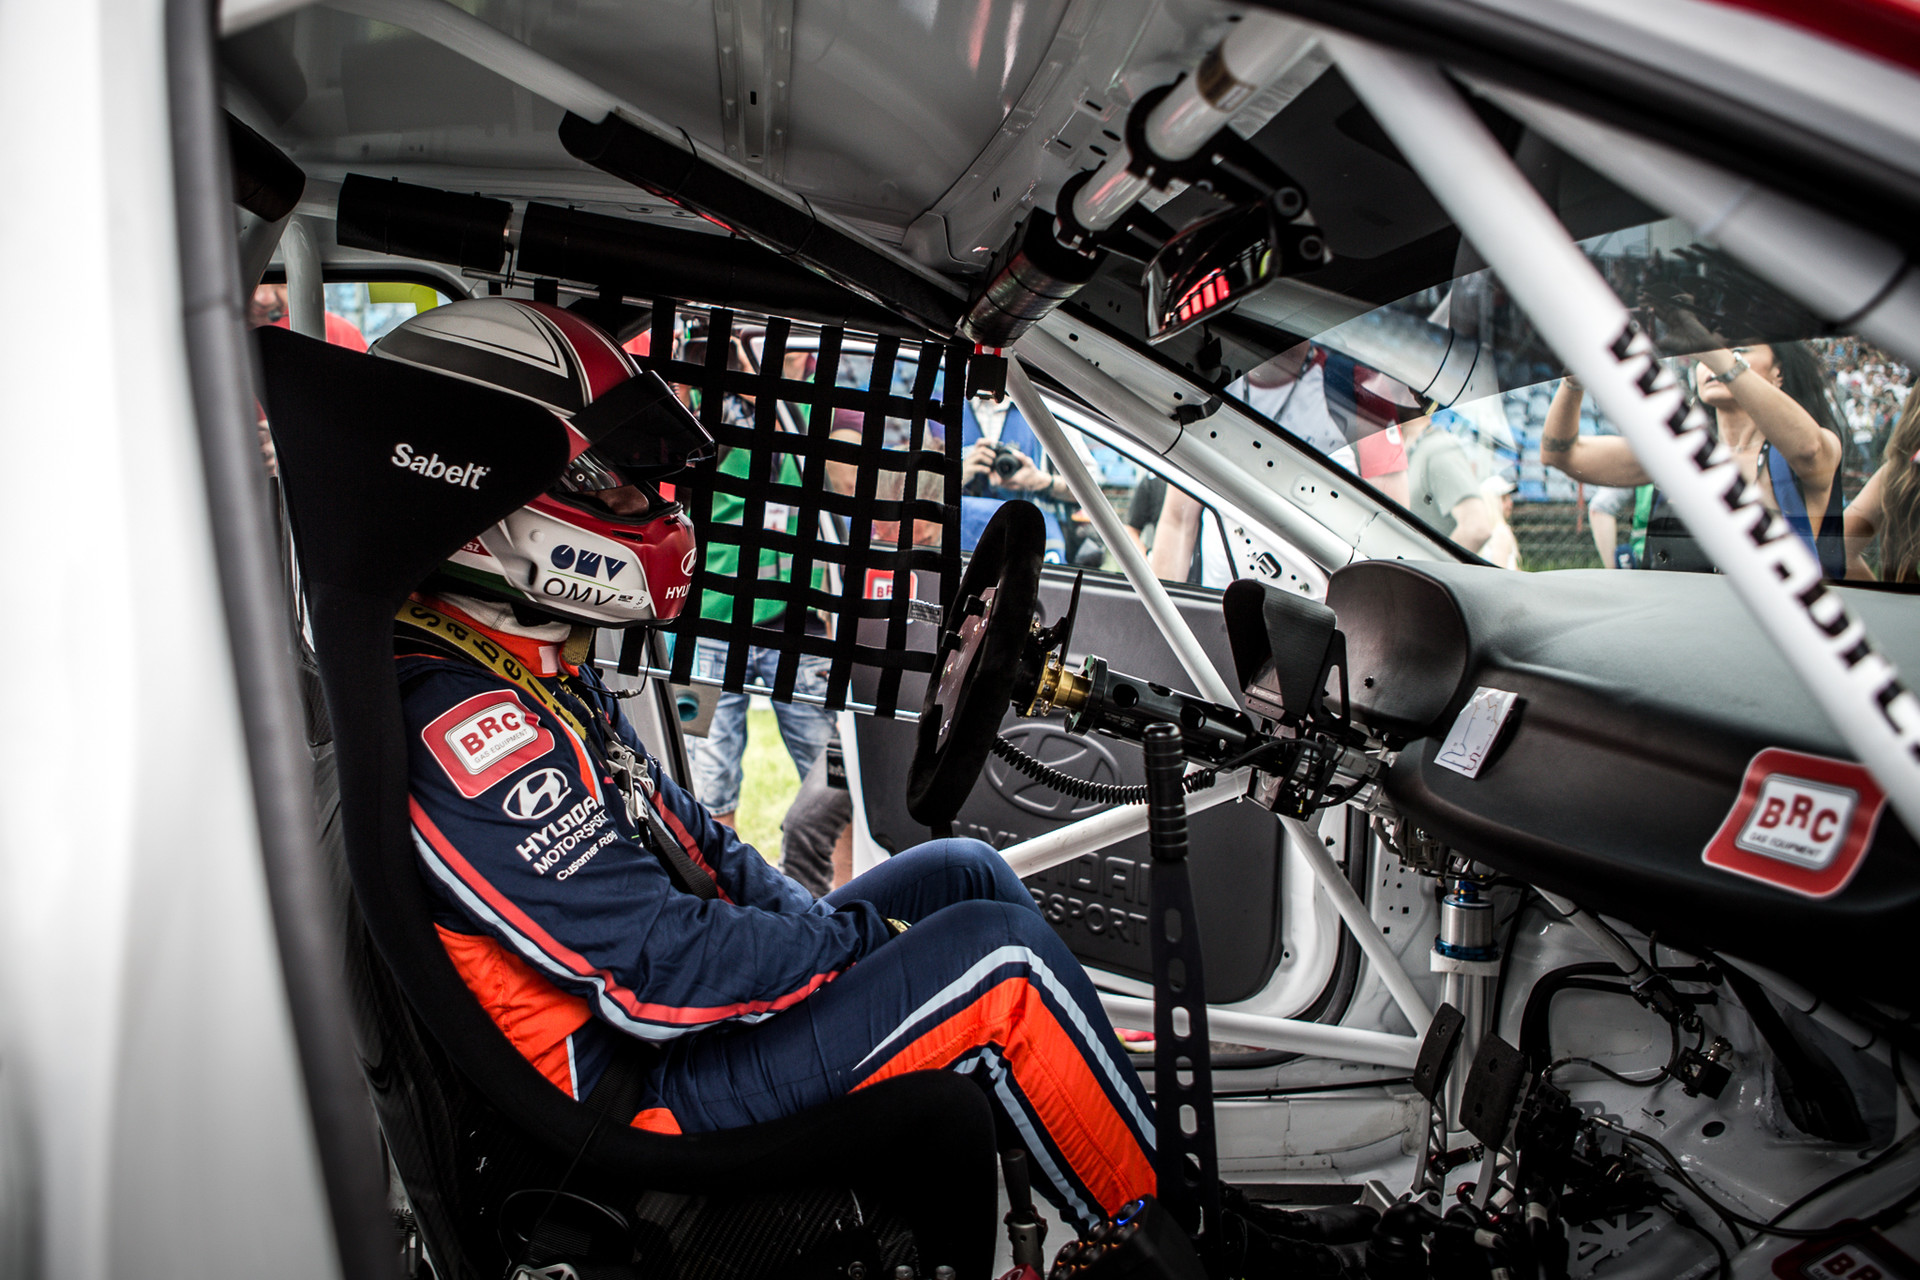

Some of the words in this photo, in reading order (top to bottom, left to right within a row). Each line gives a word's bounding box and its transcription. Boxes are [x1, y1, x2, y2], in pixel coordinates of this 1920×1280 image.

[391, 443, 486, 490] Sabelt
[550, 544, 628, 582] OMV
[543, 577, 616, 606] OMV
[409, 606, 574, 729] Sabelt
[460, 712, 521, 757] BRC
[474, 751, 491, 764] GAS
[490, 728, 529, 754] EQUIPMENT
[515, 795, 601, 862] HYUNDA
[1757, 794, 1838, 843] BRC
[556, 842, 600, 881] Customer
